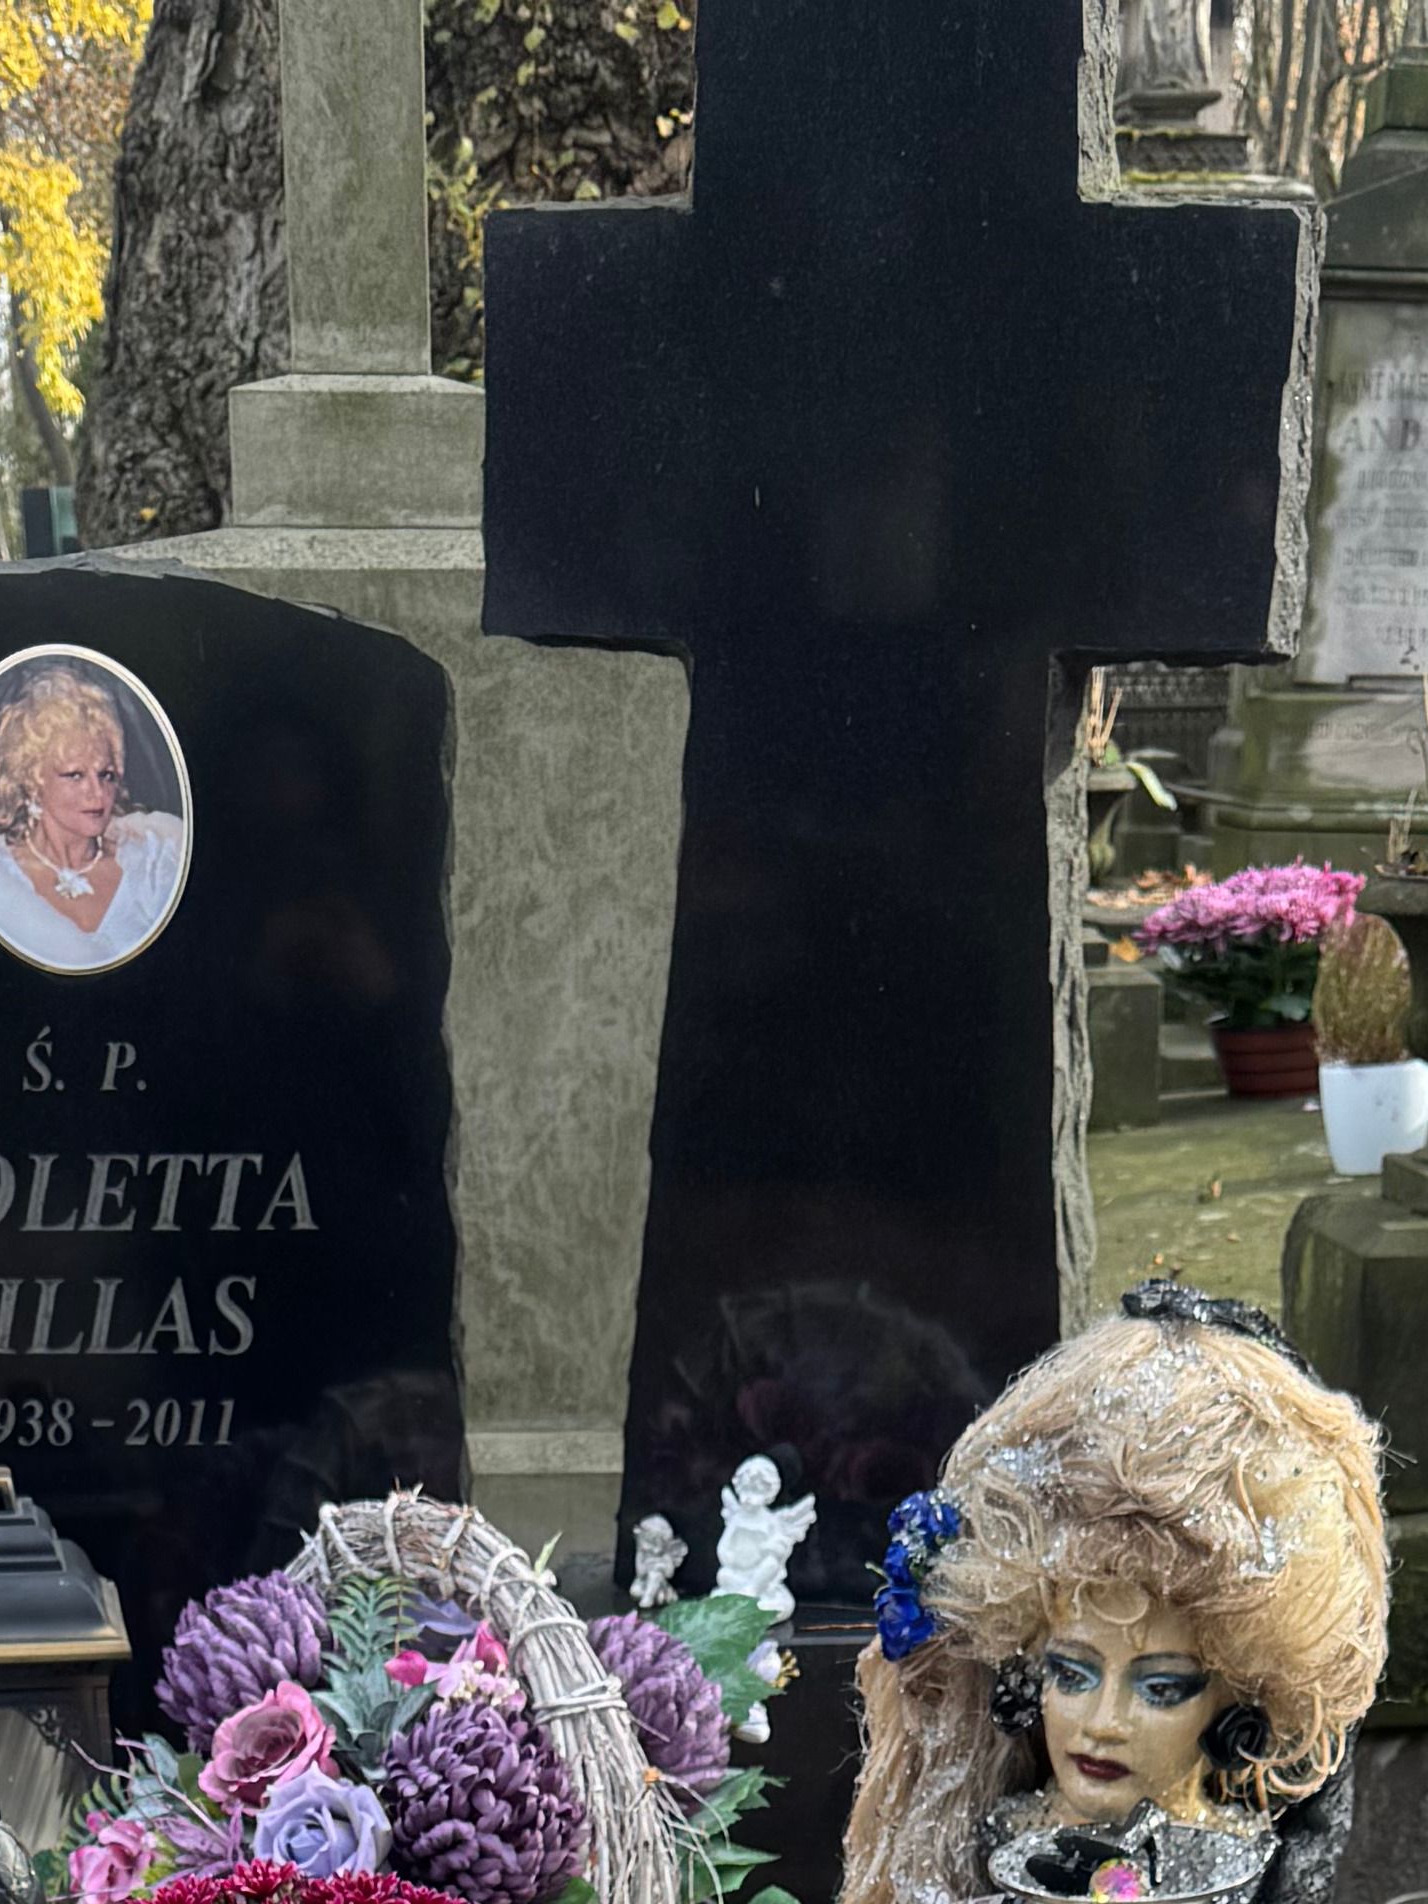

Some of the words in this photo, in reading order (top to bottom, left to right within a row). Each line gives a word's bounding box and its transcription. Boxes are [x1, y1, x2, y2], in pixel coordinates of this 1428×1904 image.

[22, 1025, 66, 1093] Ś.
[99, 1040, 148, 1093] P.
[124, 1398, 237, 1448] 2011
